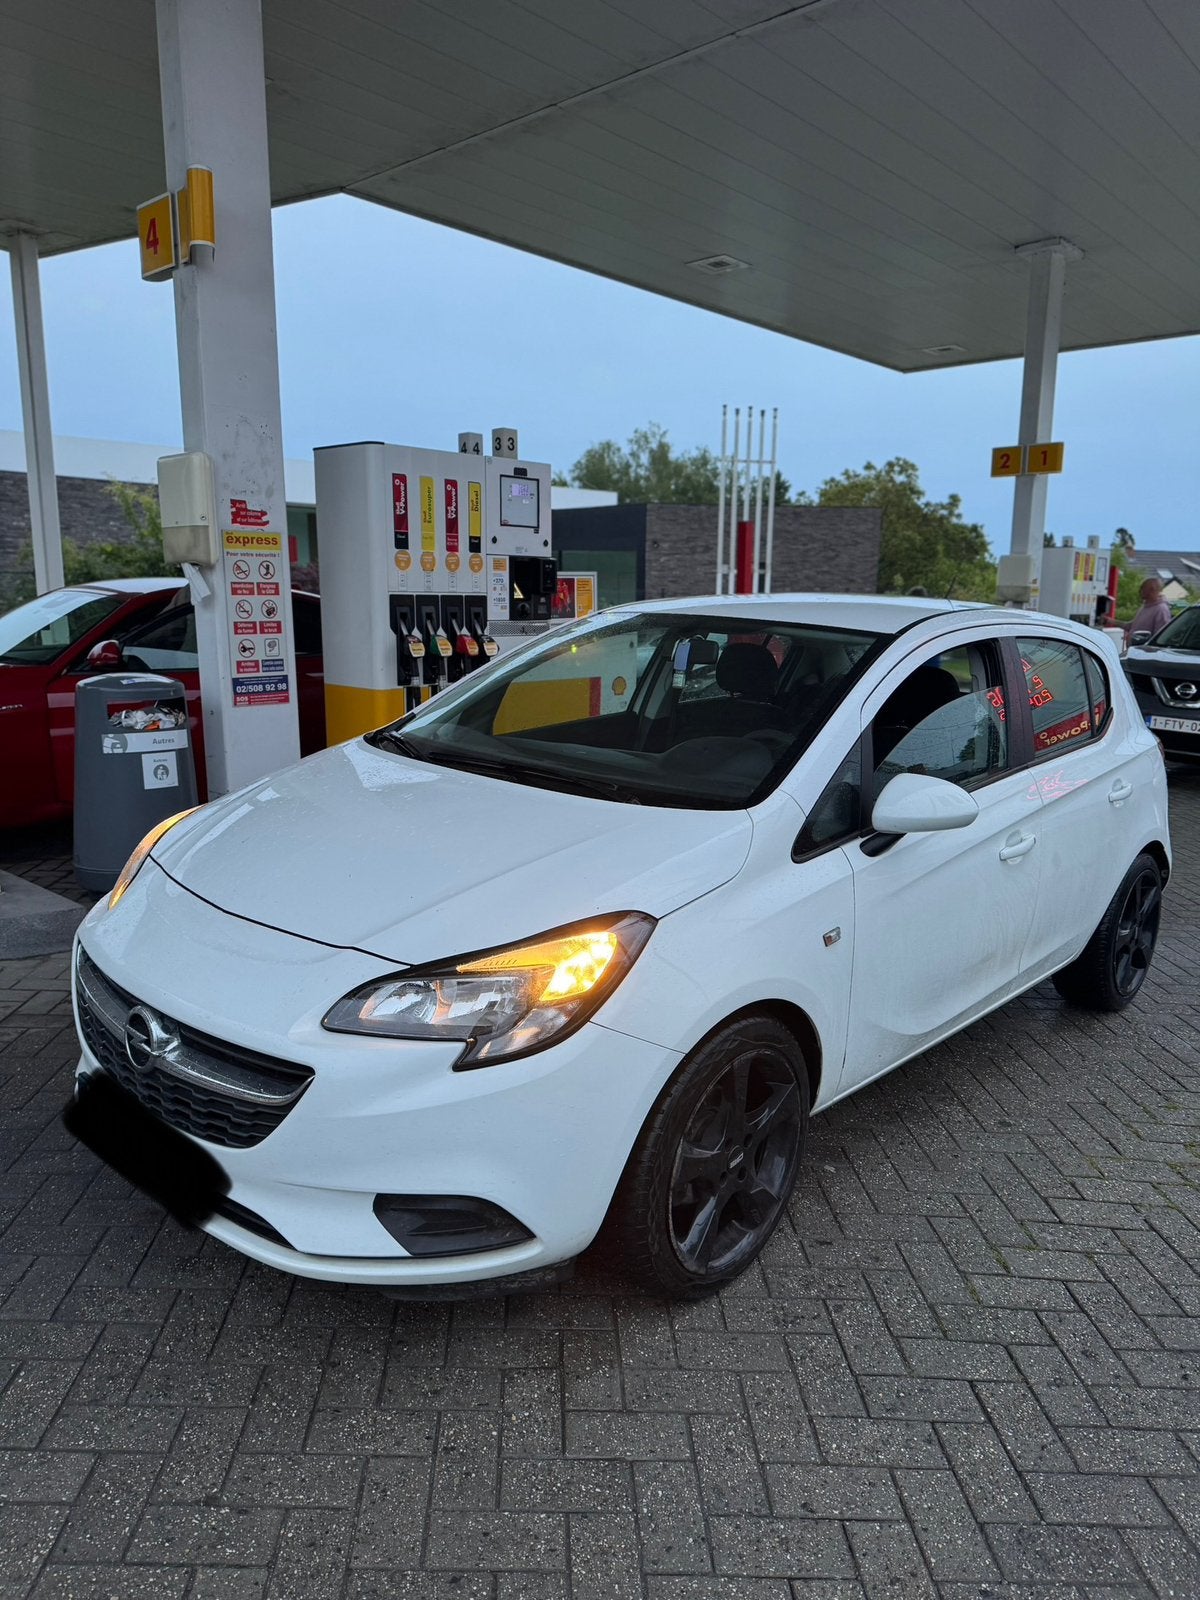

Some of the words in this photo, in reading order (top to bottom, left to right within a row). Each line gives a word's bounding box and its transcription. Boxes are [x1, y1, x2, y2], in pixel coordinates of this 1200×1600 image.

[146, 217, 160, 256] 4
[461, 441, 467, 454] 4
[473, 441, 480, 455] 4
[494, 436, 502, 451] 3
[507, 437, 515, 451] 3
[1000, 453, 1011, 469] 2
[1041, 449, 1048, 467] 1
[226, 535, 278, 547] express
[236, 684, 264, 693] 02/508
[265, 683, 276, 692] 92
[277, 682, 287, 691] 98
